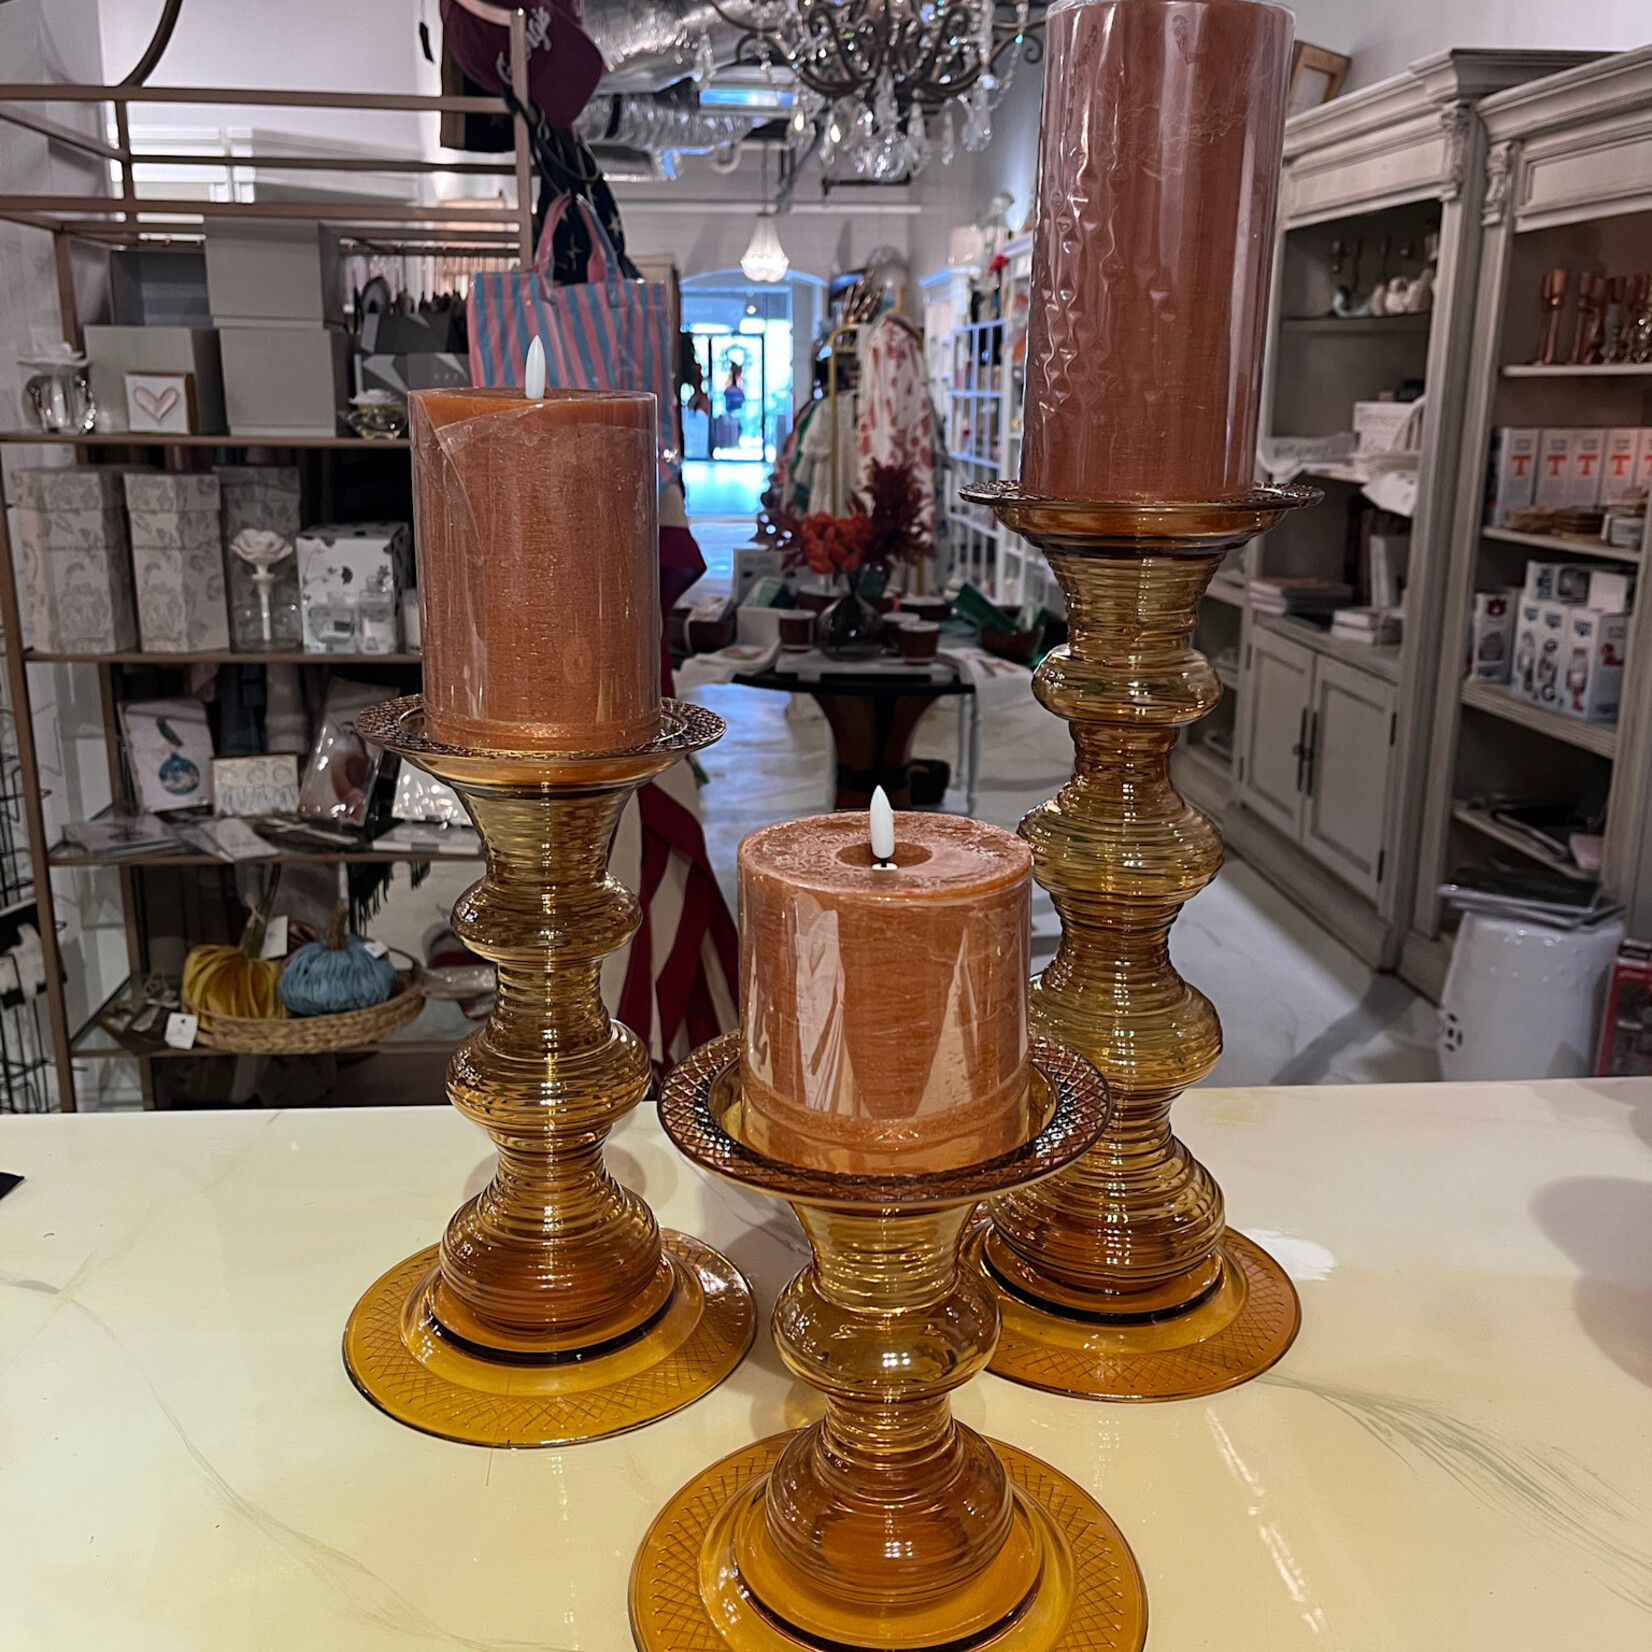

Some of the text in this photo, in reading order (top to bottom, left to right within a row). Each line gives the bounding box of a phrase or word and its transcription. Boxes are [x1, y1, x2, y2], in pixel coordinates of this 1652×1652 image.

[1512, 454, 1532, 476] T
[1547, 454, 1567, 476] T
[1578, 454, 1598, 476] T
[1611, 454, 1631, 476] T
